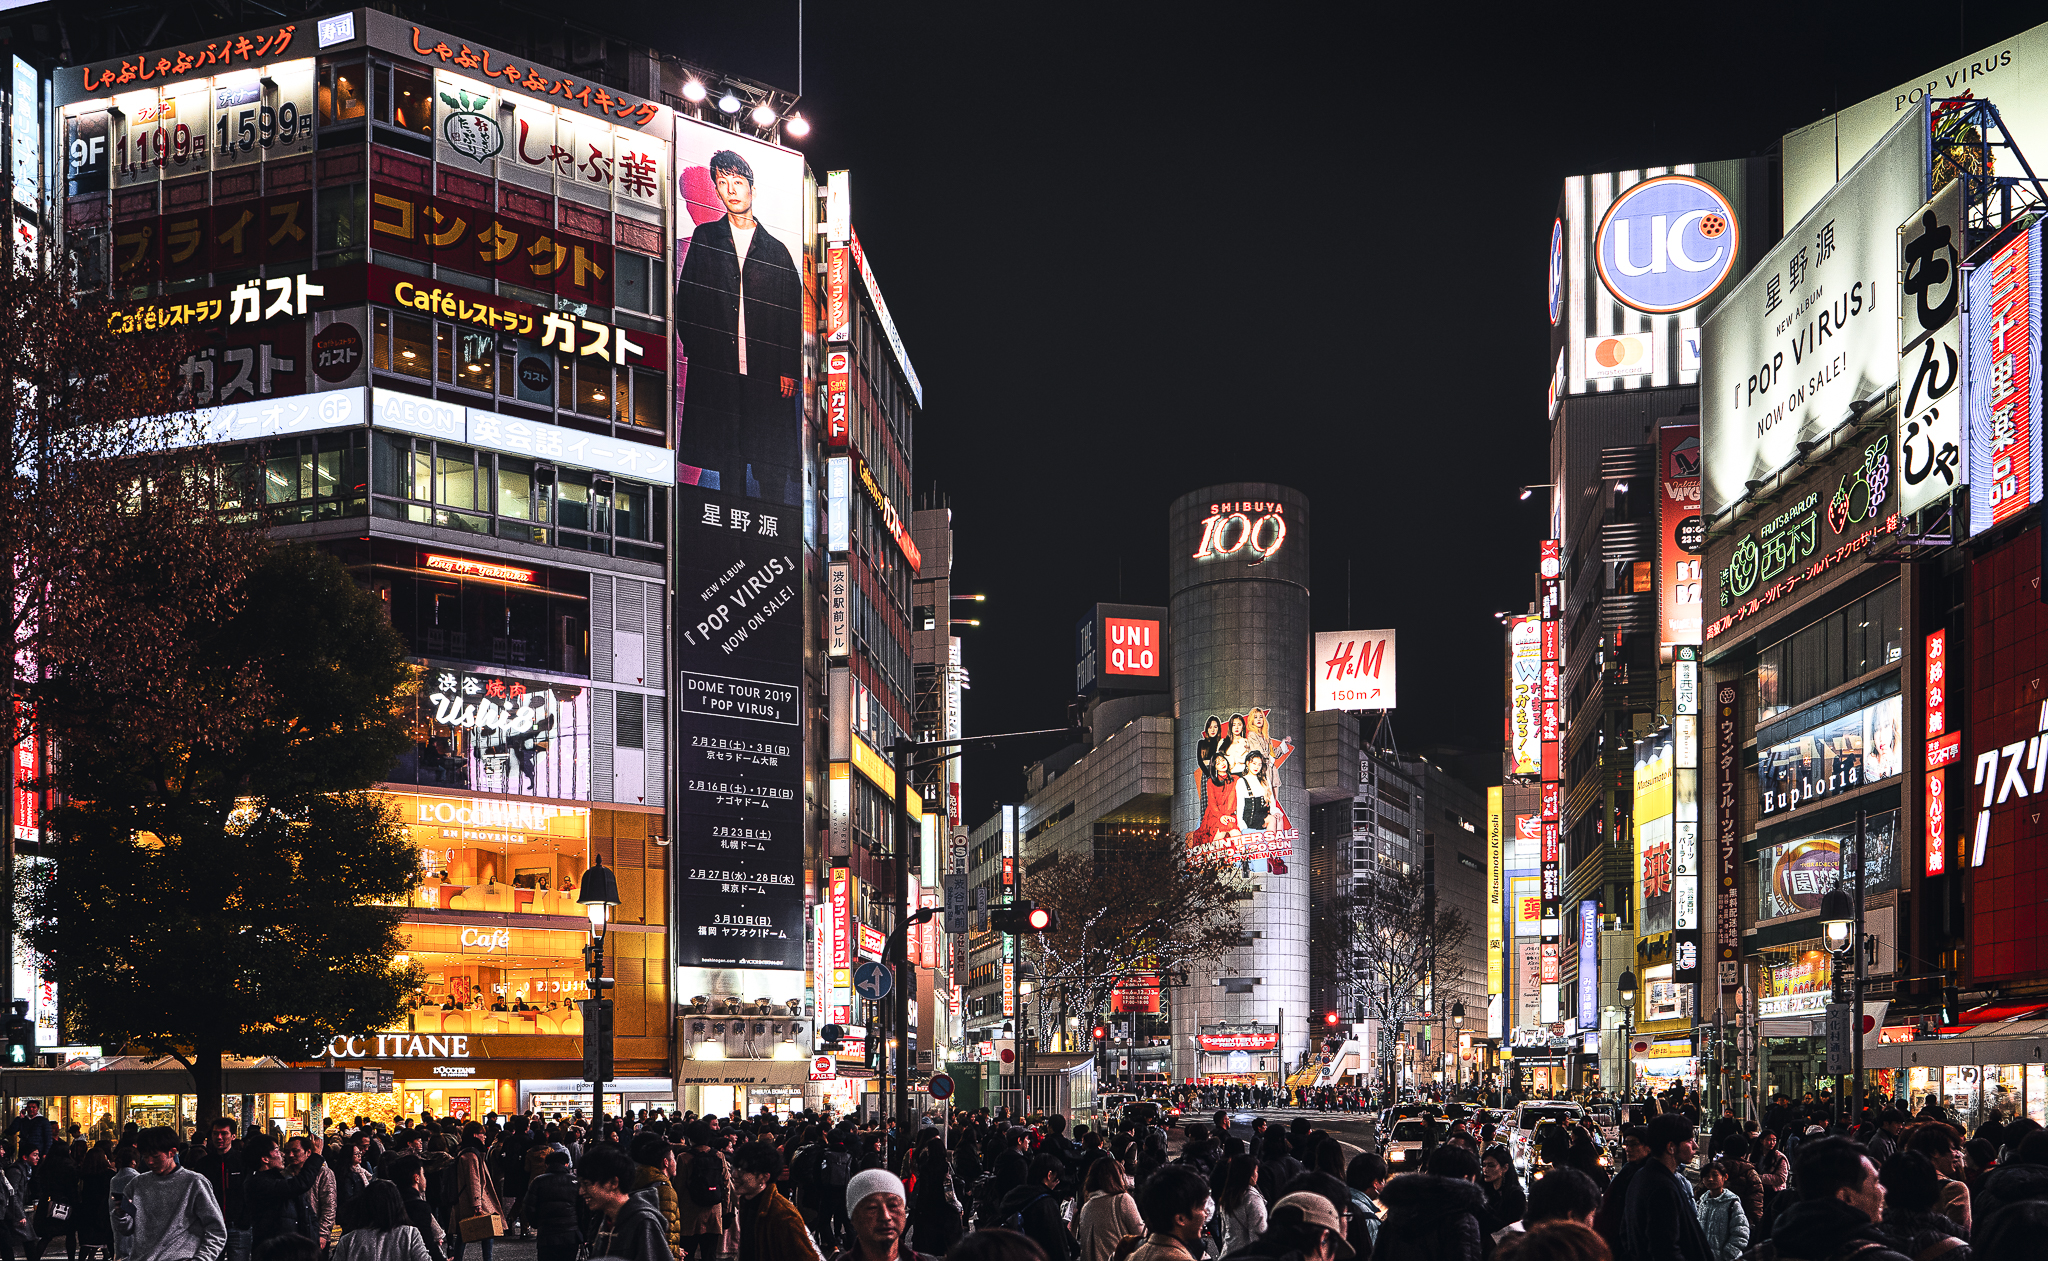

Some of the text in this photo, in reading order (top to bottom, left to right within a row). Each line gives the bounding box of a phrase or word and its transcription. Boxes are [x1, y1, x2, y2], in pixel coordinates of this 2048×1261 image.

[320, 15, 352, 41] 寿司
[83, 25, 296, 92] しゃぶしゃぶバイキング
[412, 26, 659, 126] しゃぶしゃぶバイキング
[1894, 50, 2013, 112] POP VIRUS
[70, 136, 105, 168] 9F
[518, 118, 658, 198] しゃぶ葉
[115, 201, 306, 272] プライス
[373, 193, 605, 287] コンタクト
[1764, 218, 1836, 318] 星野源
[230, 273, 325, 325] ガスト
[1776, 285, 1824, 337] NEW ALBUM
[394, 282, 533, 335] Caféレストラン
[541, 312, 644, 365] ガスト
[836, 331, 848, 340] 8F
[318, 347, 358, 367] ガスト
[1903, 209, 1959, 487] もんじゃ
[1757, 401, 1784, 439] NOW
[1788, 384, 1805, 412] ON
[1809, 351, 1847, 396] SALE!
[1988, 248, 2019, 509] 三千里薬品
[322, 398, 349, 420] 6F
[382, 398, 456, 433] AEON
[831, 391, 846, 437] ガスト
[701, 503, 779, 537] 星野源
[1210, 502, 1283, 514] SHIBUYA
[1192, 512, 1287, 567] 109
[1761, 511, 1818, 582] 西村
[700, 559, 746, 601] NEW ALBUM
[1719, 568, 1729, 607] 渋谷
[721, 585, 795, 655] NOW ON SALE!
[832, 571, 845, 650] 渋谷駅前ビル
[1080, 620, 1092, 657] THE
[1111, 625, 1150, 647] UNI
[1111, 649, 1154, 671] QLO
[1325, 639, 1387, 681] H&M
[688, 679, 792, 703] DOME TOUR 2019
[1331, 690, 1368, 701] 150m
[1928, 636, 1944, 735] お好み焼
[706, 750, 778, 766] 京セラドーム大阪
[1974, 731, 2048, 808] クスリ
[716, 796, 769, 808] ナゴヤドーム
[1720, 720, 1735, 875] ウィンターフルーツギフト
[1763, 763, 1859, 815] Euphoria
[18, 828, 34, 839] 7F
[463, 831, 525, 844] PROVENCE
[720, 839, 765, 851] 札幌ドーム
[1263, 829, 1300, 841] SALE
[1267, 840, 1292, 850] SUN
[1929, 776, 1944, 872] もんじゃ焼
[1248, 849, 1294, 860] NEW YEAR
[721, 884, 765, 894] 東京ドーム
[954, 879, 965, 929] 渋谷駅前
[460, 929, 510, 953] Café
[698, 926, 717, 936] 福岡
[833, 894, 847, 964] サンドラッグ
[923, 925, 934, 953] アコム
[1585, 909, 1594, 949] MIZUHO
[1003, 968, 1013, 1014] HOOTERS
[1582, 977, 1593, 1019] みずほ銀行
[1829, 1009, 1840, 1064] 文化村通り
